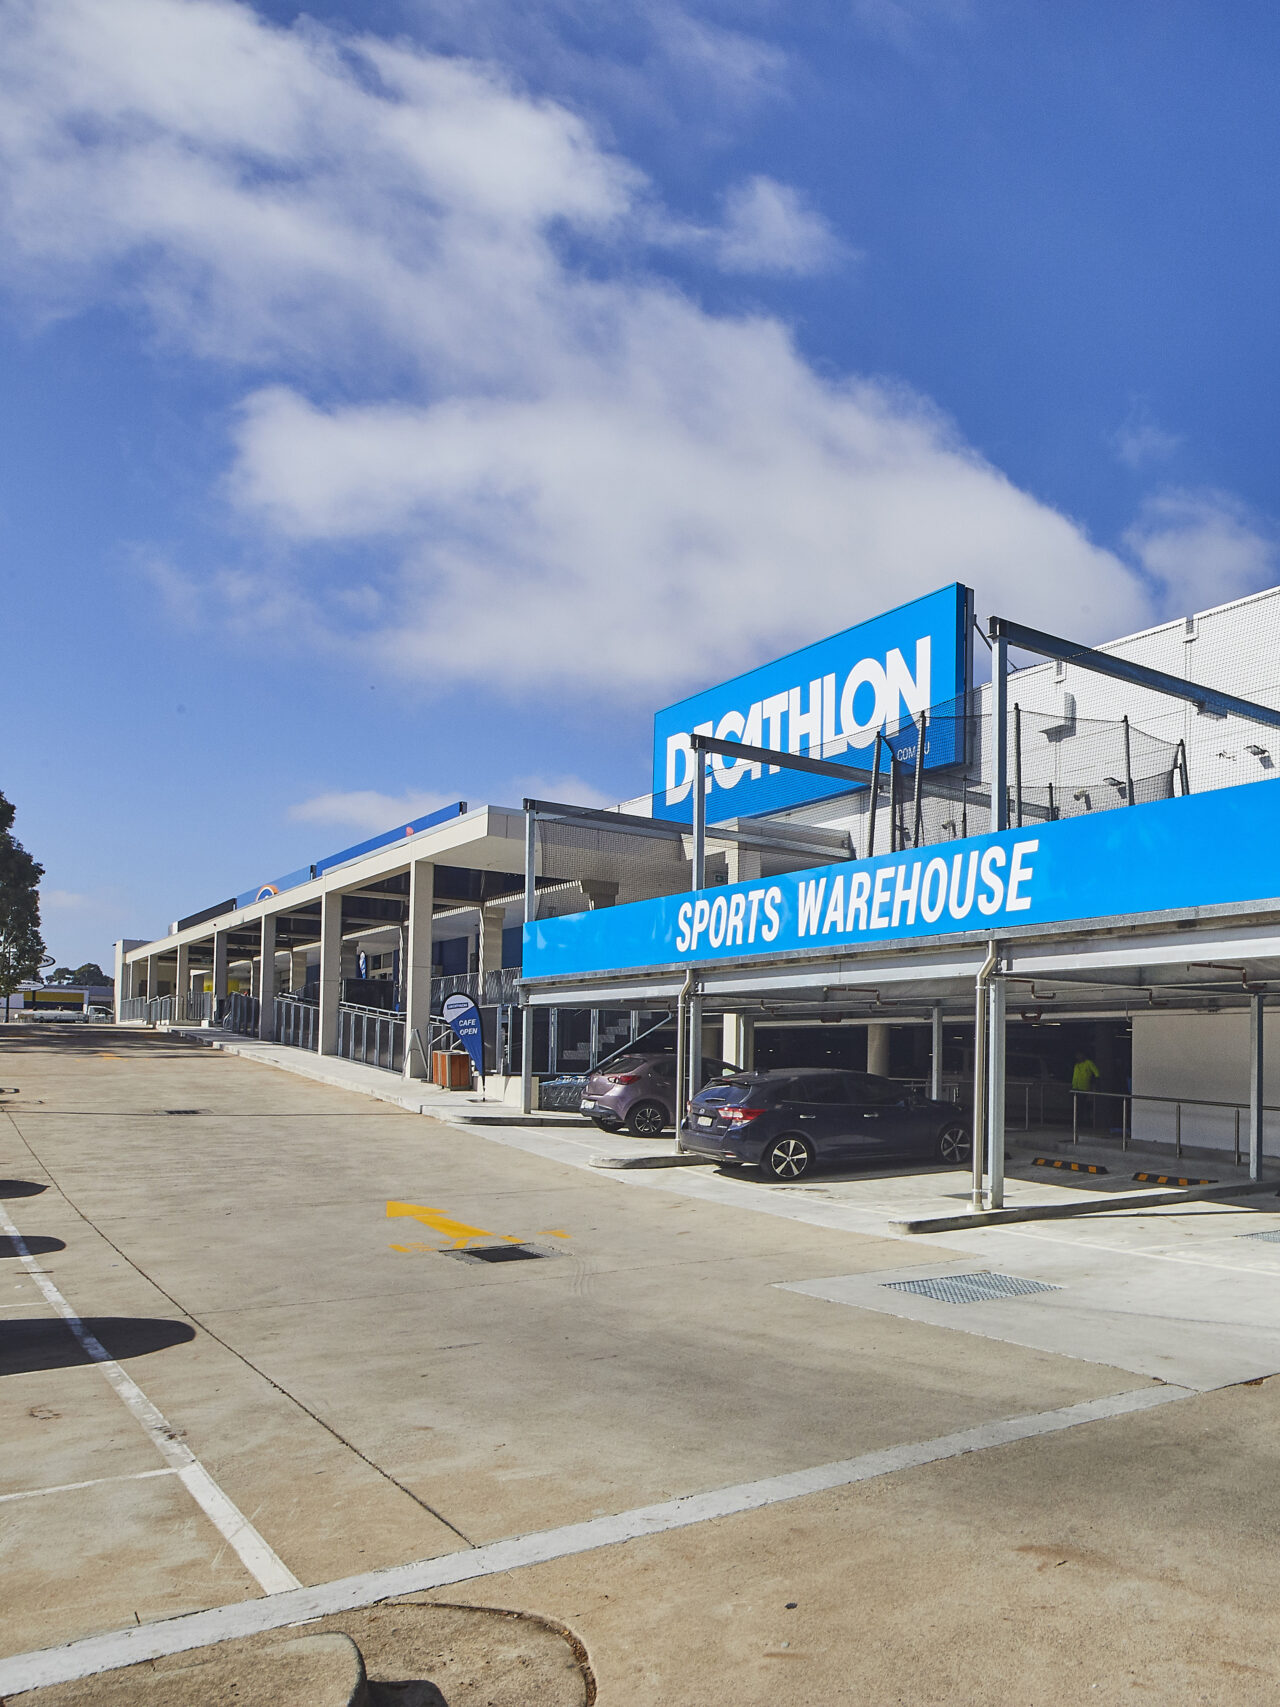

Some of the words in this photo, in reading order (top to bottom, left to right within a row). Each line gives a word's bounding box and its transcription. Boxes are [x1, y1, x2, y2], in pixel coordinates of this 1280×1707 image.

[897, 741, 930, 761] COMU
[675, 886, 782, 952] SPORTS
[798, 839, 1039, 937] WAREHOUSE
[459, 1028, 478, 1036] OPEN
